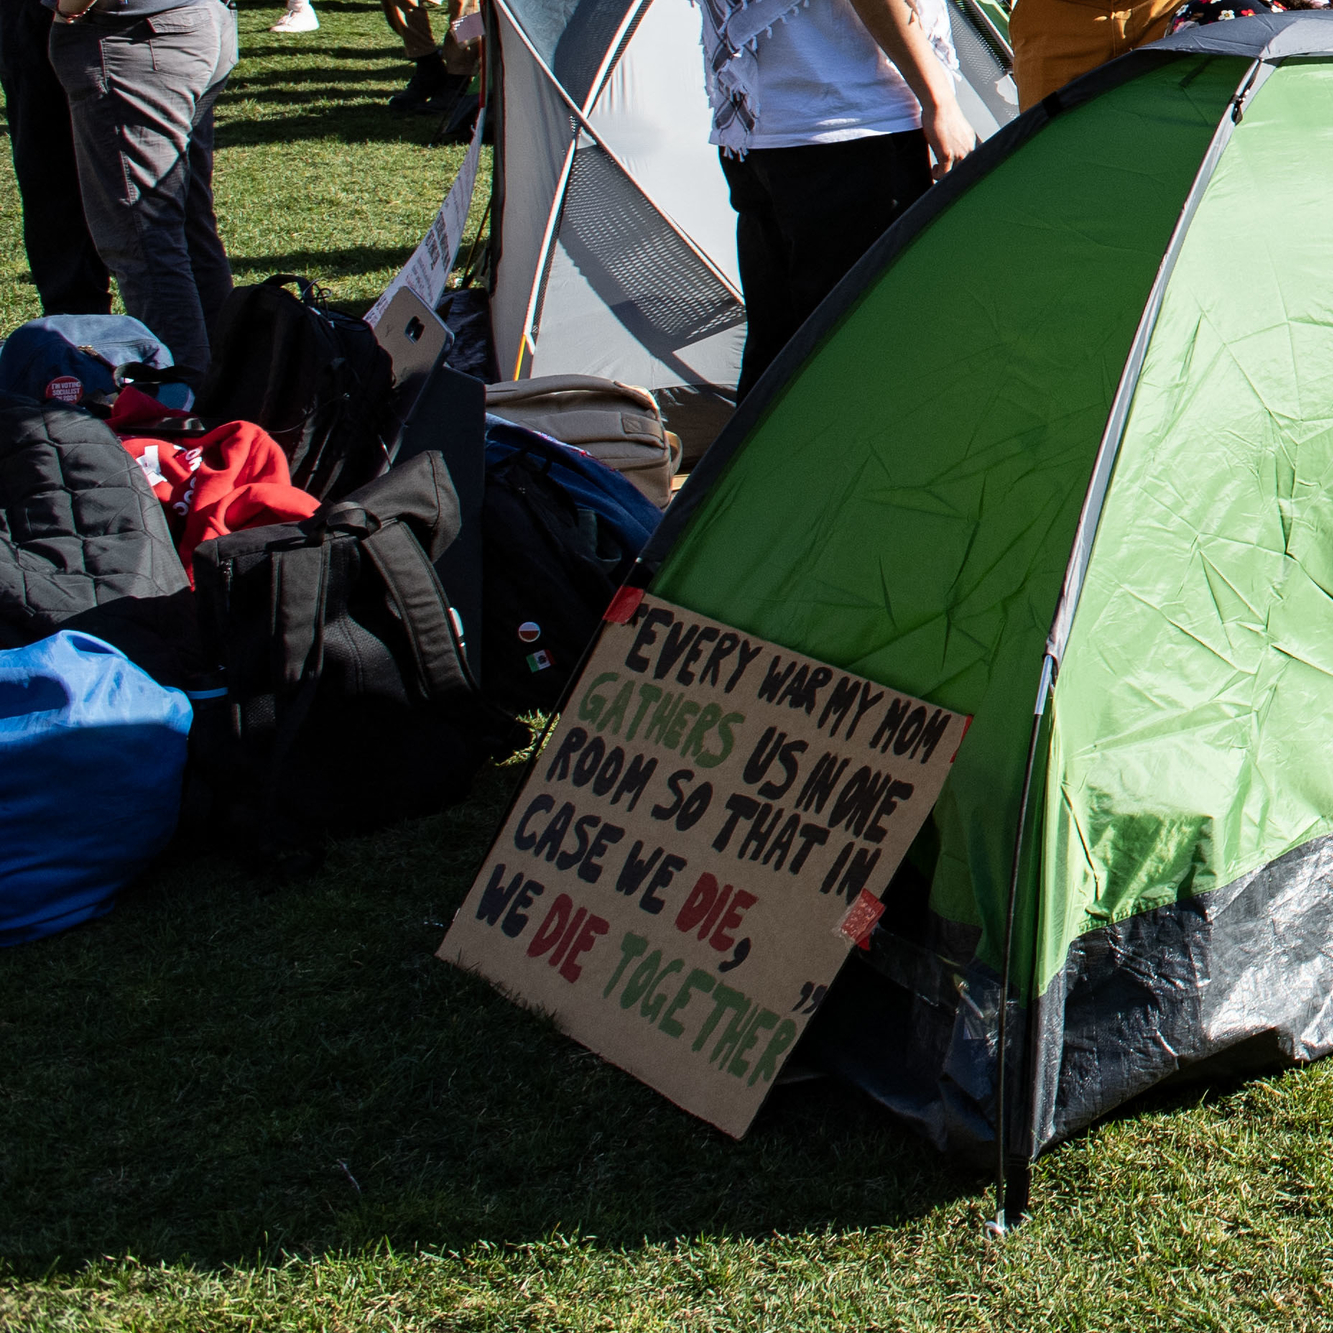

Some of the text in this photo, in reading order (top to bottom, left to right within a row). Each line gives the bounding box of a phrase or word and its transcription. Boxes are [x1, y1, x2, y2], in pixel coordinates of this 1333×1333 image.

[579, 672, 915, 843] GATHERS US IN ONE
[764, 656, 823, 715] WAR
[819, 679, 881, 739] MY
[873, 701, 952, 764] MOM
[515, 795, 759, 972] CASE WE DIE,
[547, 728, 884, 904] ROOM SO THAT IN
[476, 863, 545, 938] WE
[528, 894, 610, 983] DIE
